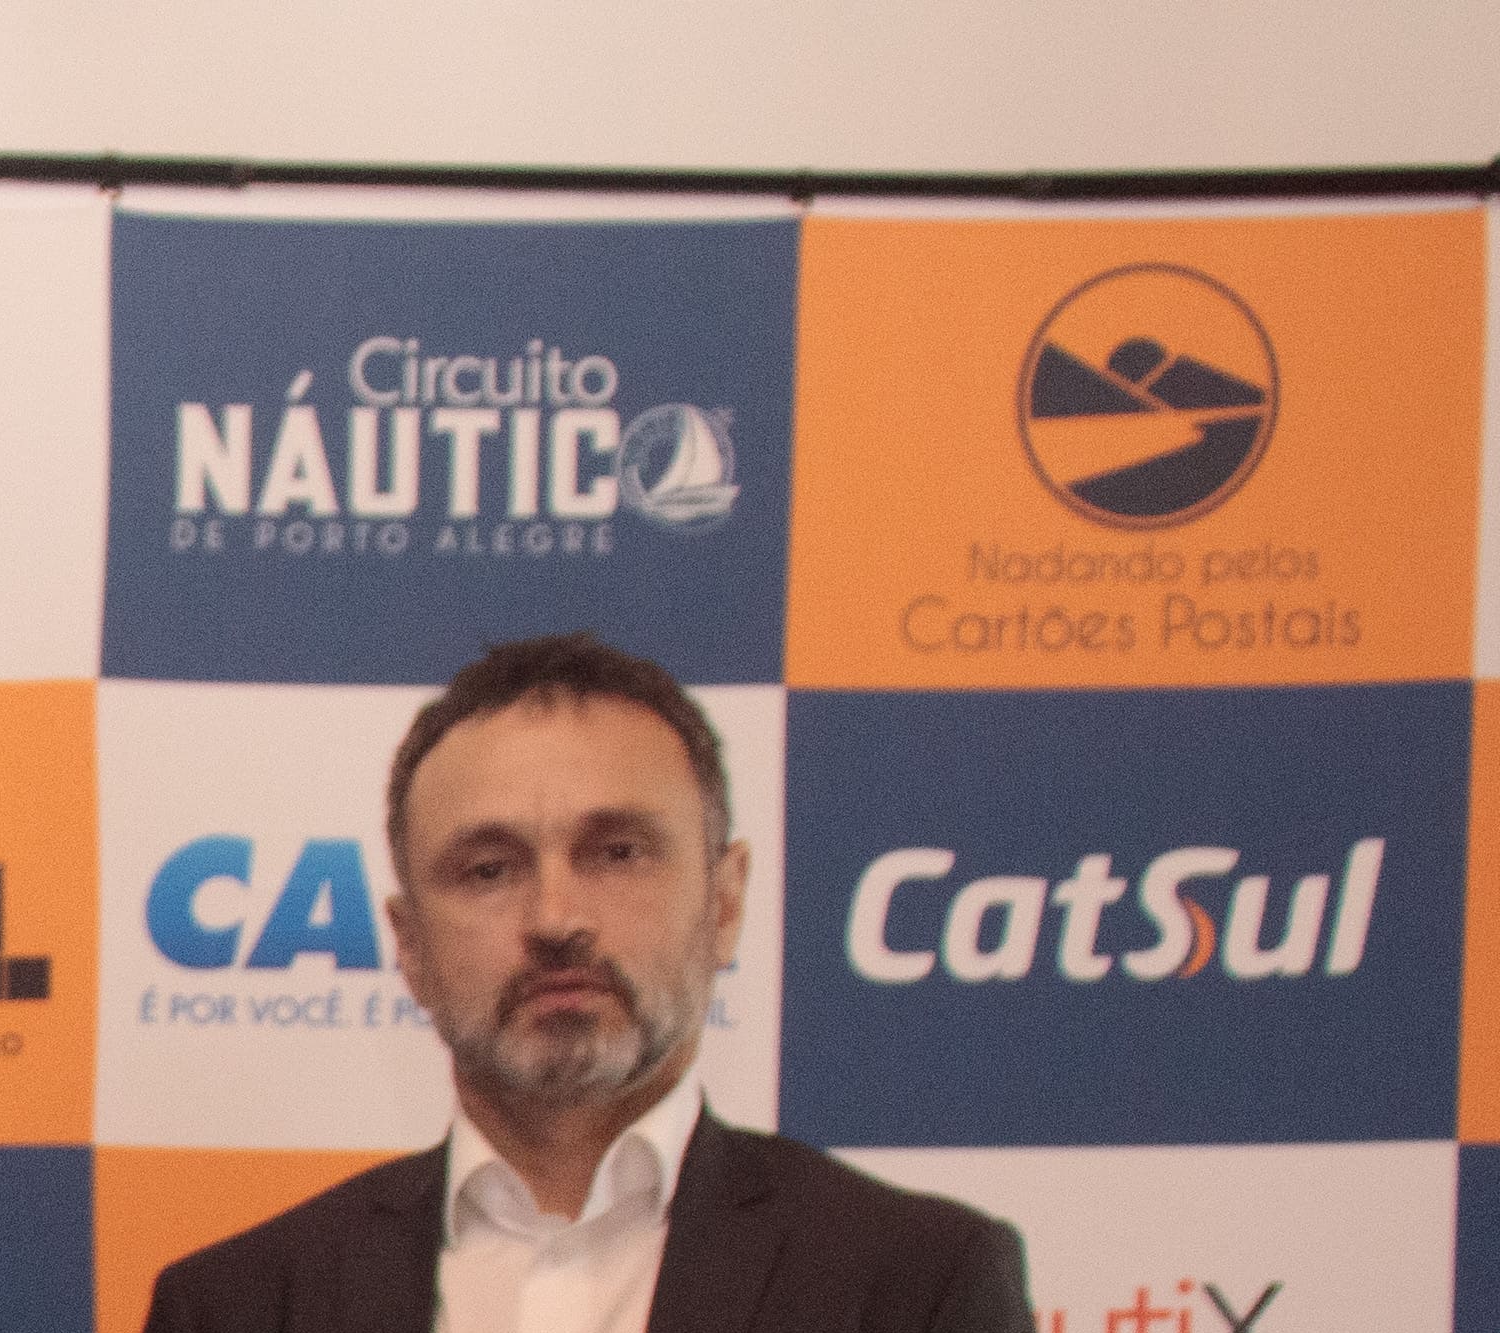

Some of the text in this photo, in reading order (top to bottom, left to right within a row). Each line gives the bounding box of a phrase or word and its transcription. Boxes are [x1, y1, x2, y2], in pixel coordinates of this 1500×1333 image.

[350, 337, 618, 402] Circuito
[172, 520, 615, 555] DE PORTO ALEGRE
[967, 543, 1184, 585] Nadando
[901, 593, 1362, 654] Cartões Postais
[845, 837, 1386, 983] CatSul
